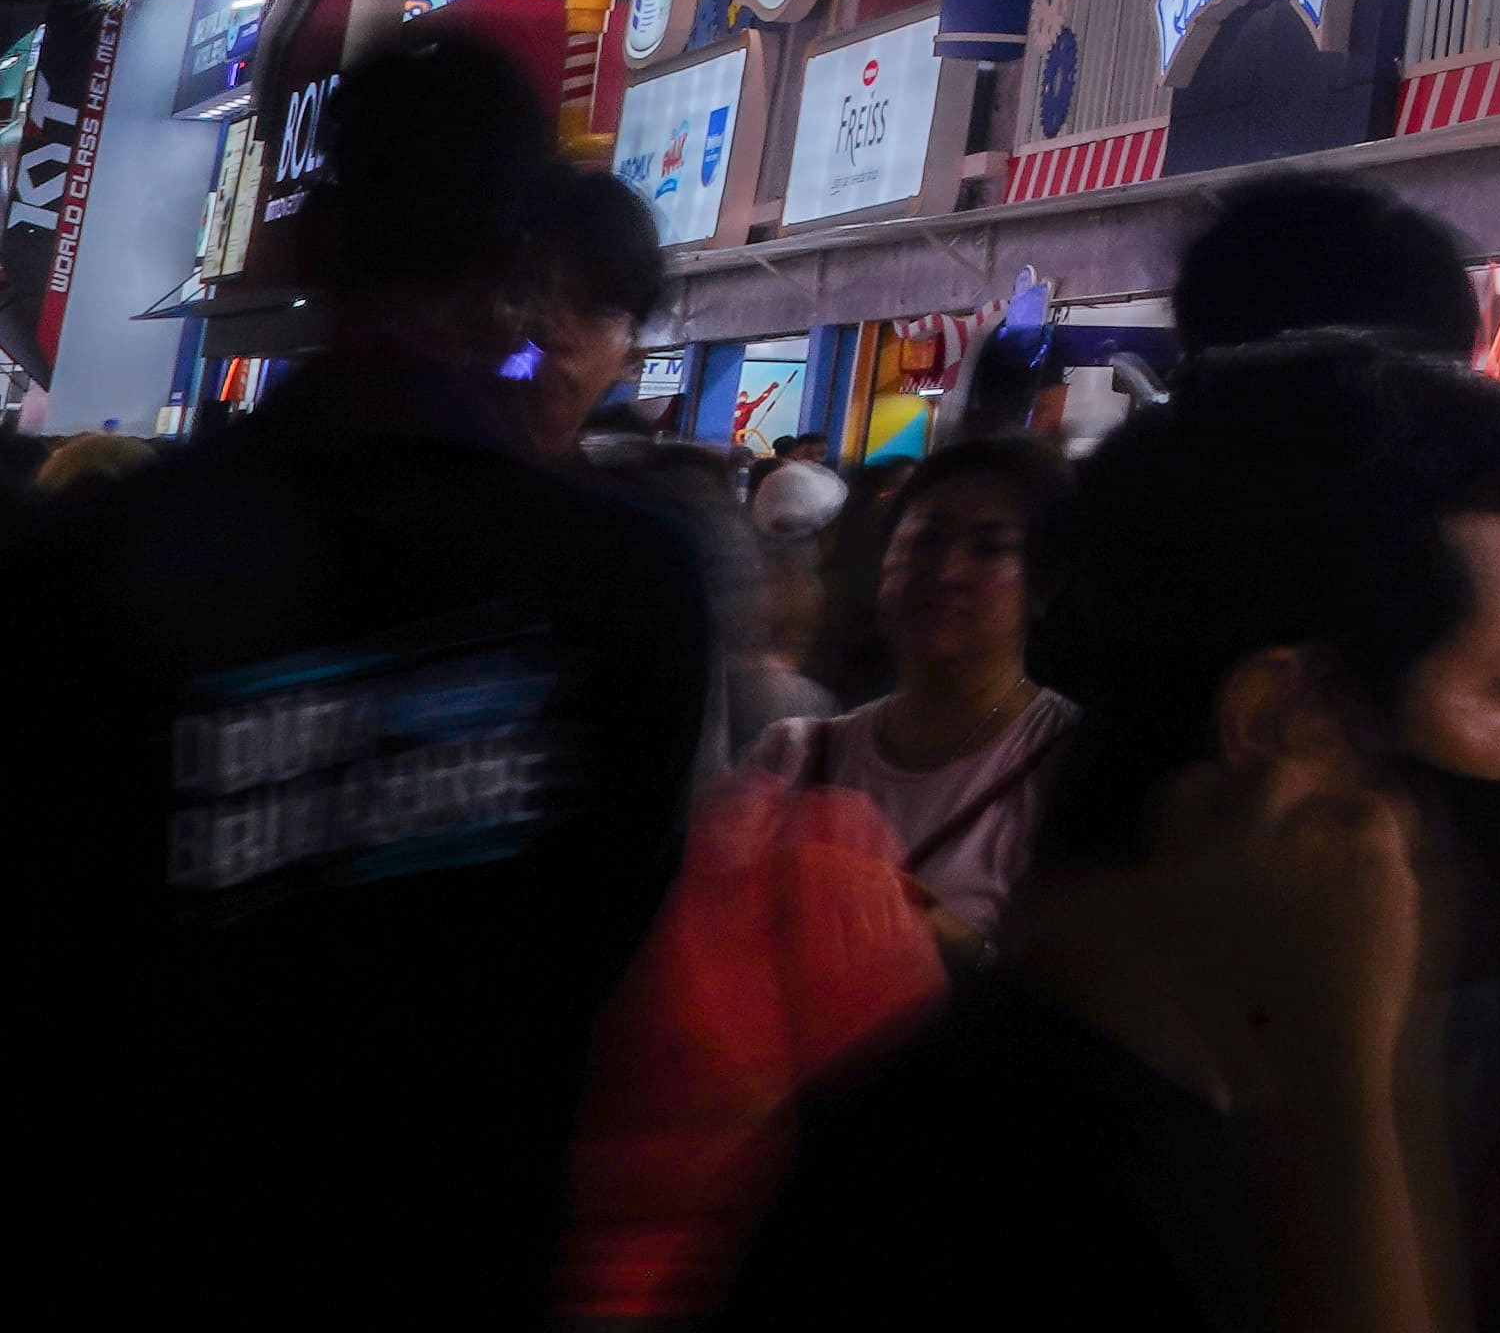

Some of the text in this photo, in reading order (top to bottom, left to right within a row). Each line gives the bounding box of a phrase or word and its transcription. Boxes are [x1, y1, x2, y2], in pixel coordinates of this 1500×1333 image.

[50, 12, 122, 294] WORLD CLASS HELMET
[275, 72, 342, 184] BOL
